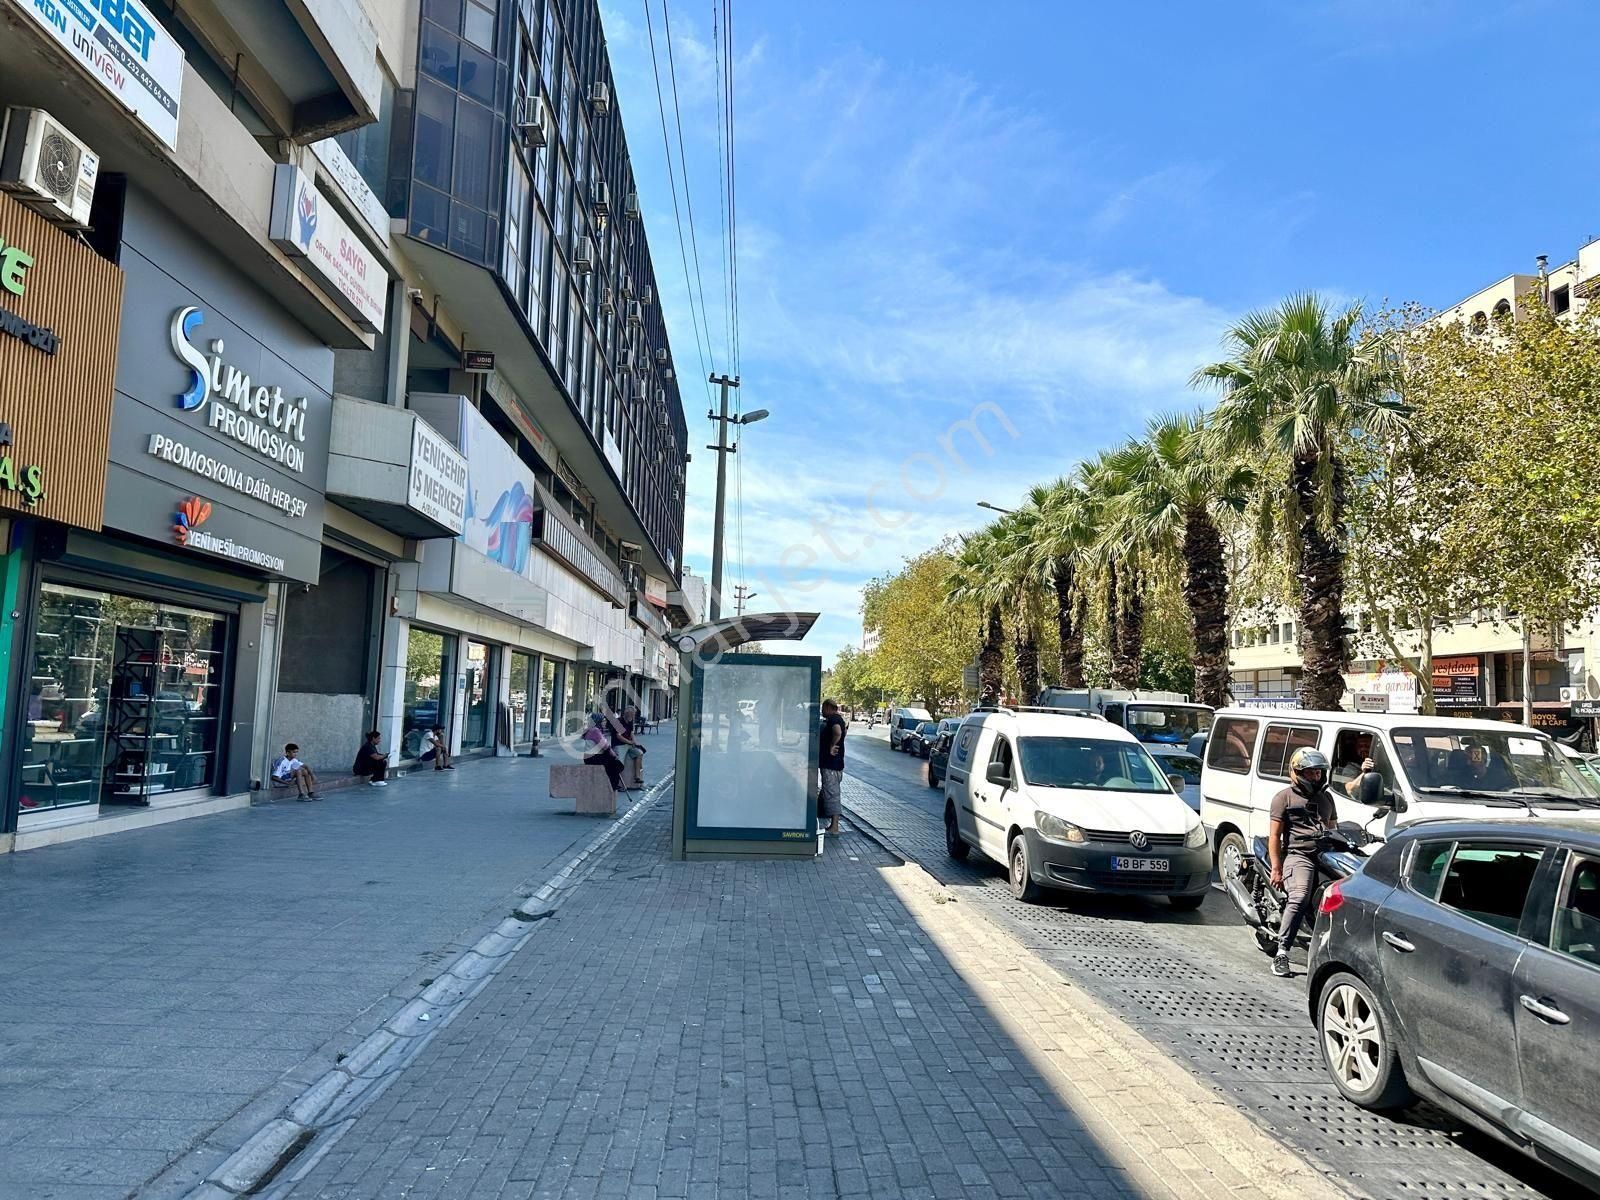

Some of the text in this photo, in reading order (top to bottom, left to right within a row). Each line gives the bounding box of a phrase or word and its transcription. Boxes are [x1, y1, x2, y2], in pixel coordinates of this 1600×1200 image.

[72, 28, 125, 90] uniview
[121, 53, 126, 61] 0
[127, 58, 139, 76] 232
[140, 73, 153, 90] 442
[154, 86, 162, 99] 66
[315, 239, 332, 264] ORTAK
[340, 238, 366, 281] SAYGI
[170, 306, 308, 442] Simetri
[210, 401, 304, 473] PROMOSYON
[417, 431, 466, 489] YENİŞEHİR
[149, 433, 308, 518] PROMOSYONA DAİR HER ŞEY
[412, 459, 464, 519] İŞ MERKEZİ
[187, 529, 284, 572] YENİ NESİL PROMOSYON
[1116, 859, 1168, 871] 48 BF 559
